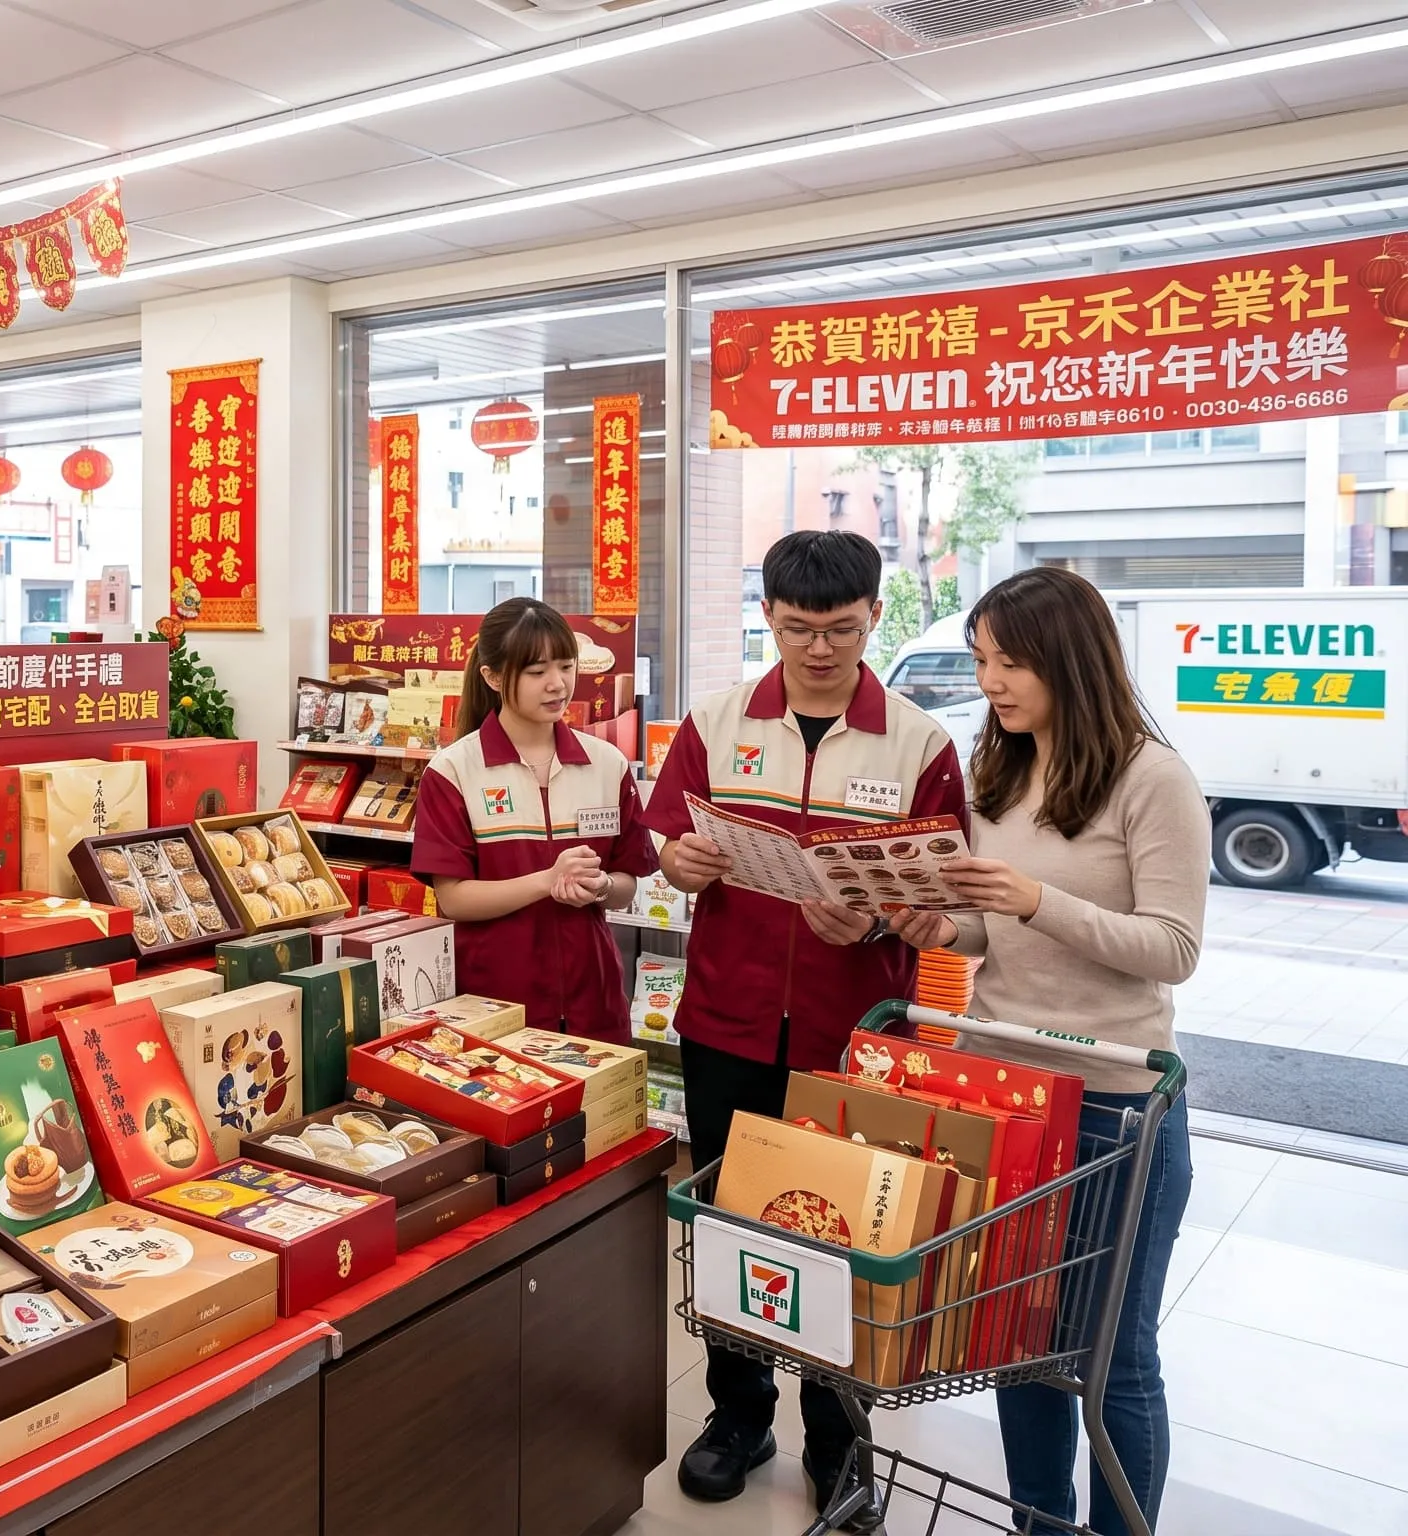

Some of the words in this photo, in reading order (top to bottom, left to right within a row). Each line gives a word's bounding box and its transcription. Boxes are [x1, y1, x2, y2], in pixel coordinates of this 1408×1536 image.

[770, 304, 980, 368] 恭賀新禧
[1018, 258, 1350, 350] 京禾企業社
[984, 326, 1348, 408] 祝您新年快樂
[1186, 388, 1349, 418] 0030-436-6686
[1214, 671, 1355, 703] 宅急便
